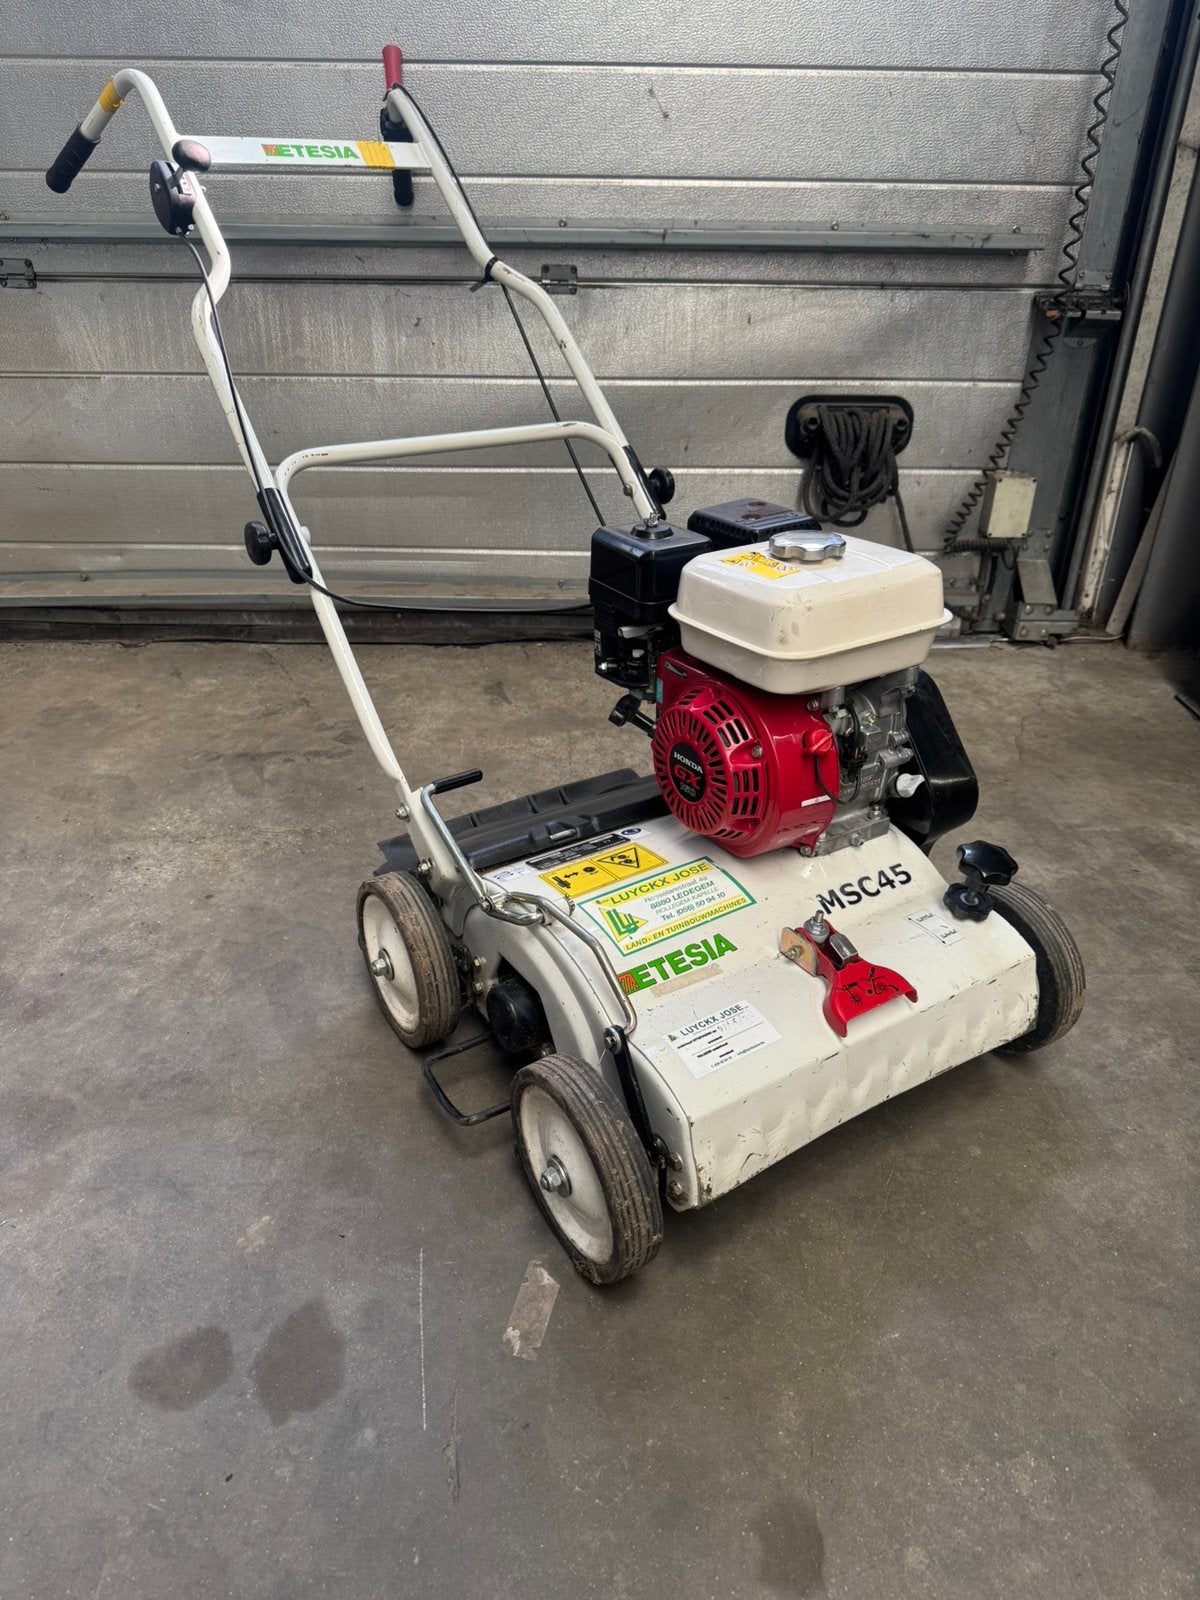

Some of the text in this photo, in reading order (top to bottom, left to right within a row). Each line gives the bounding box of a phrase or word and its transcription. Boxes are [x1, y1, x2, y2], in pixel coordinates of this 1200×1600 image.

[276, 144, 360, 159] ETESIA
[673, 751, 703, 774] HONDA
[674, 764, 702, 790] GX
[610, 862, 709, 905] LUYCKX JOSE
[672, 880, 715, 901] LEDEGEM
[816, 863, 912, 915] MSC45
[653, 931, 665, 940] EN
[666, 897, 747, 935] TUINBOUWMACHINES
[661, 911, 676, 921] Tel.
[717, 891, 726, 899] 10
[630, 933, 738, 989] ETESIA
[679, 1015, 719, 1037] LUYCKX
[720, 1004, 744, 1019] JOSE
